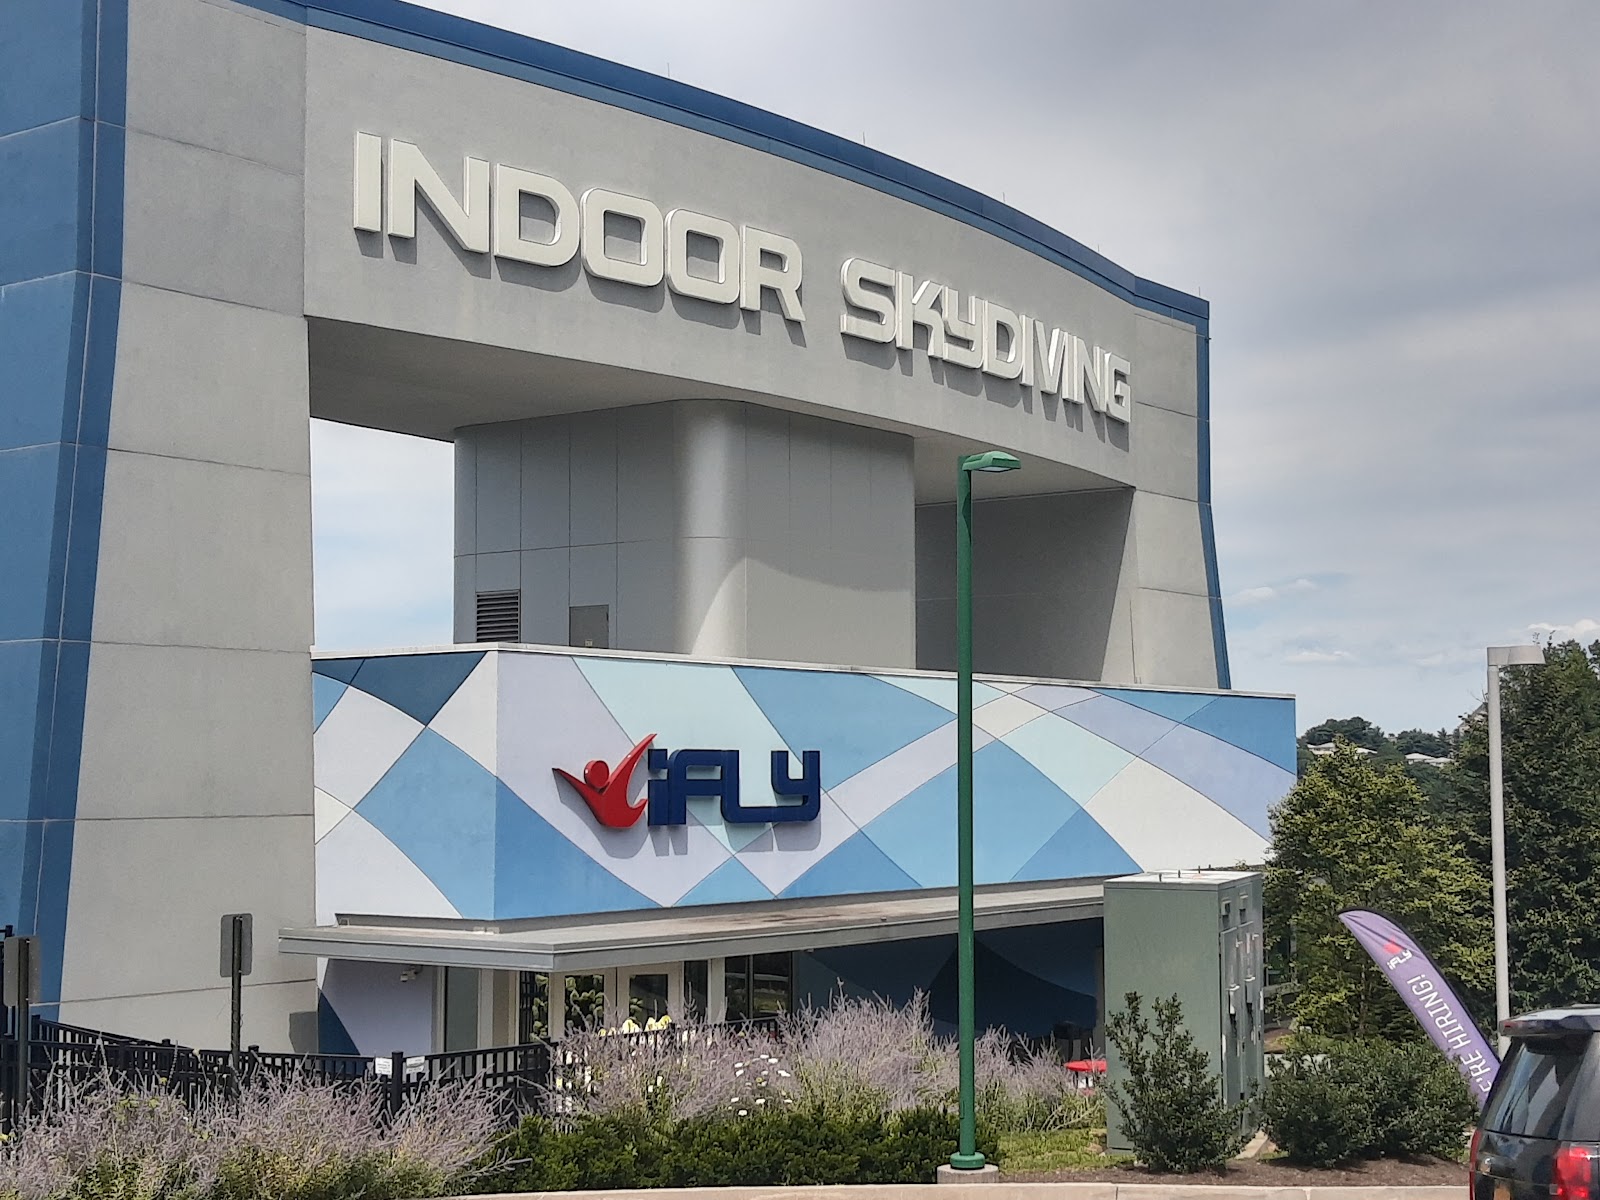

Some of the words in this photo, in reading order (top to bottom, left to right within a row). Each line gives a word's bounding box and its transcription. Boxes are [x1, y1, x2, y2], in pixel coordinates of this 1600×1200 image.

[353, 131, 806, 323] INDOOR
[840, 257, 1131, 424] SKYDIVING
[1406, 974, 1472, 1050] HIRING!
[1460, 1049, 1493, 1092] E'RE
